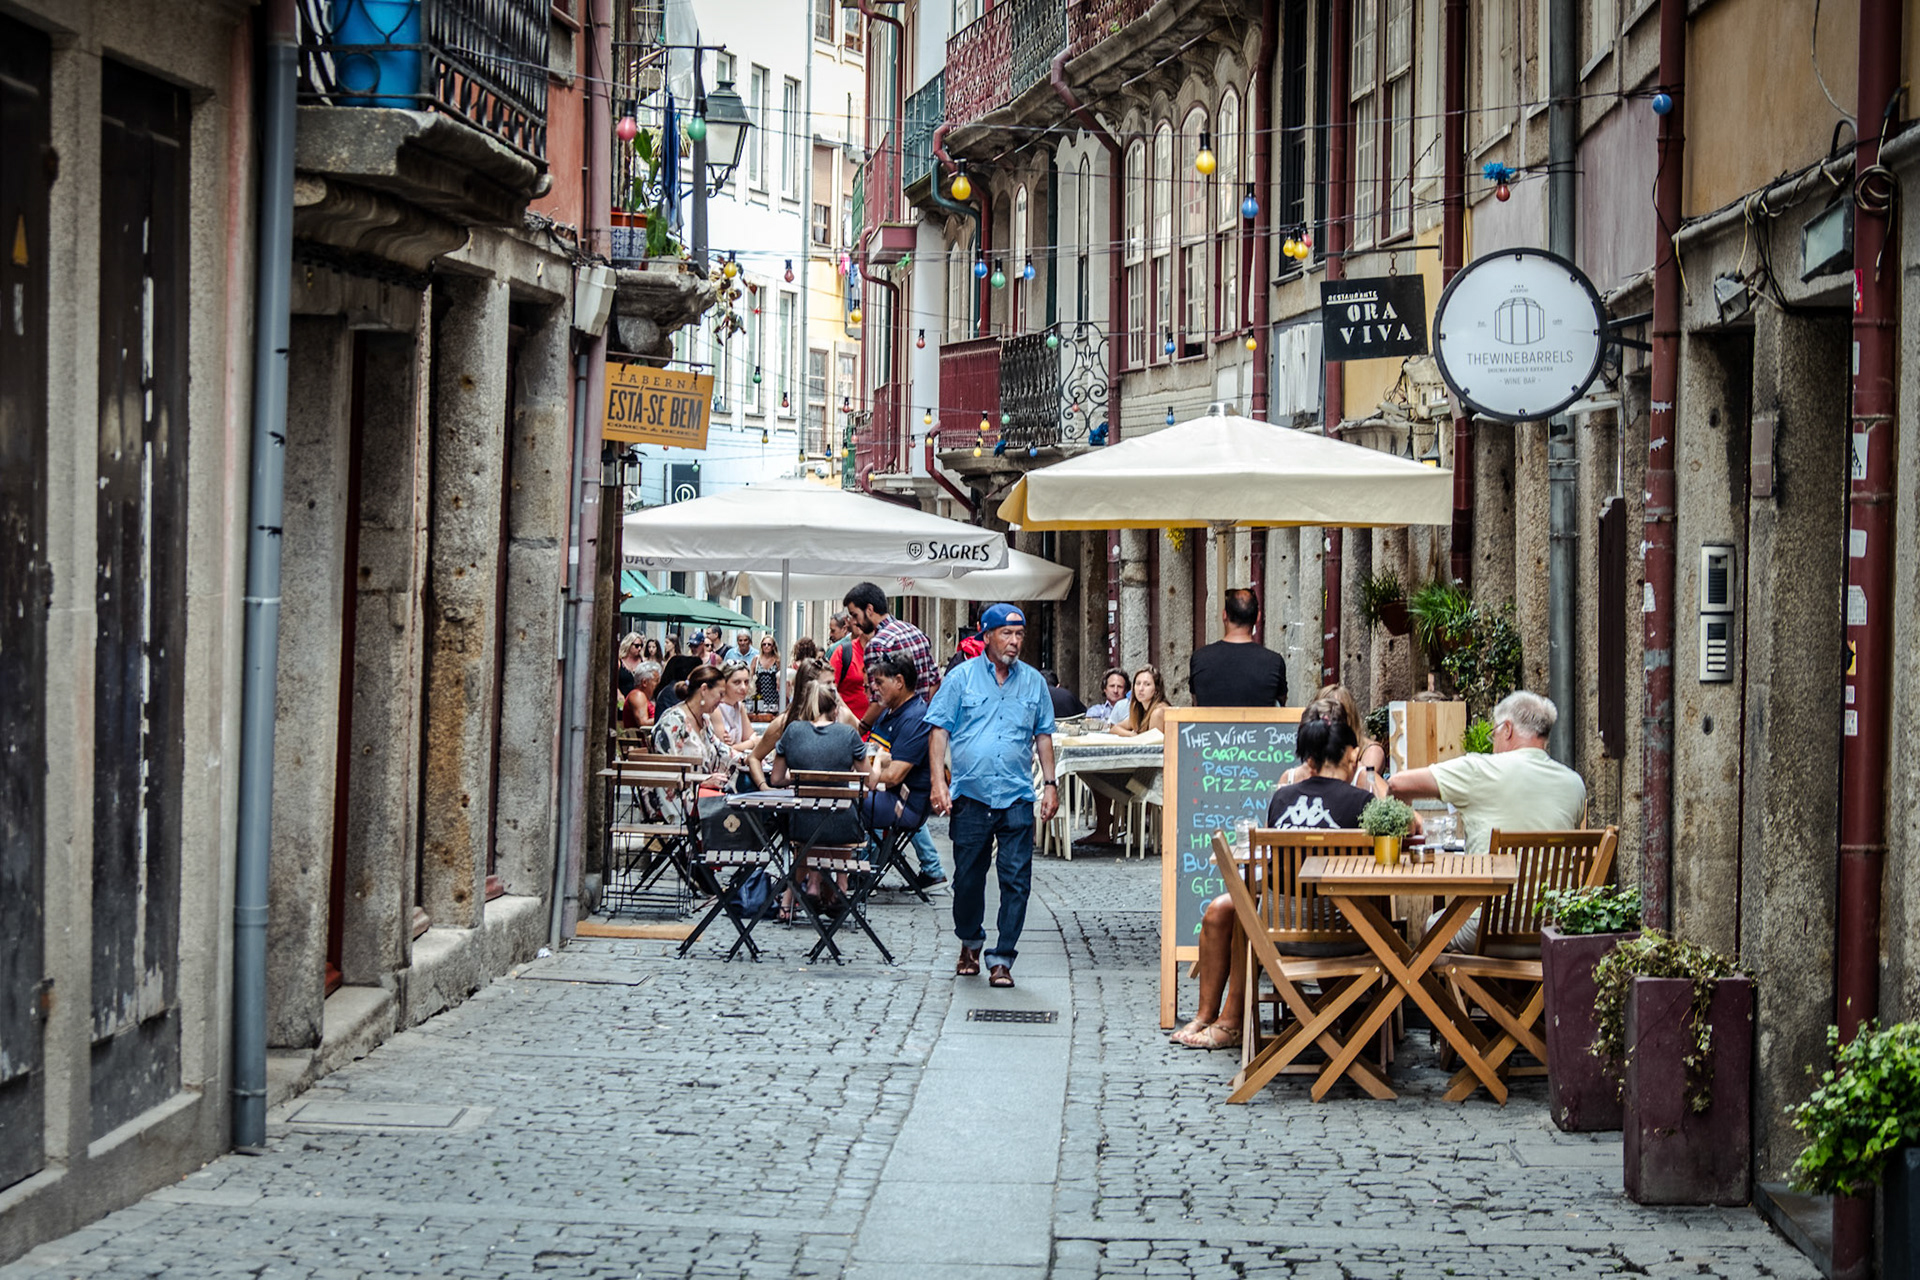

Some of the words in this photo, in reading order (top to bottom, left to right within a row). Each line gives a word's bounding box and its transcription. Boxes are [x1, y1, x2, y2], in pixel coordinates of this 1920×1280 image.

[1347, 301, 1398, 323] ORA
[1340, 323, 1412, 345] VIVA
[1466, 350, 1574, 366] THEWINEBARRELS
[618, 372, 698, 391] TABERNA
[1503, 376, 1521, 385] WINE
[1523, 375, 1536, 385] BAR
[607, 385, 668, 427] ESTÁ-SE
[669, 396, 704, 431] BEM
[927, 540, 990, 562] SAGRES
[1180, 723, 1212, 749] THE
[1201, 761, 1260, 778] PASTAS
